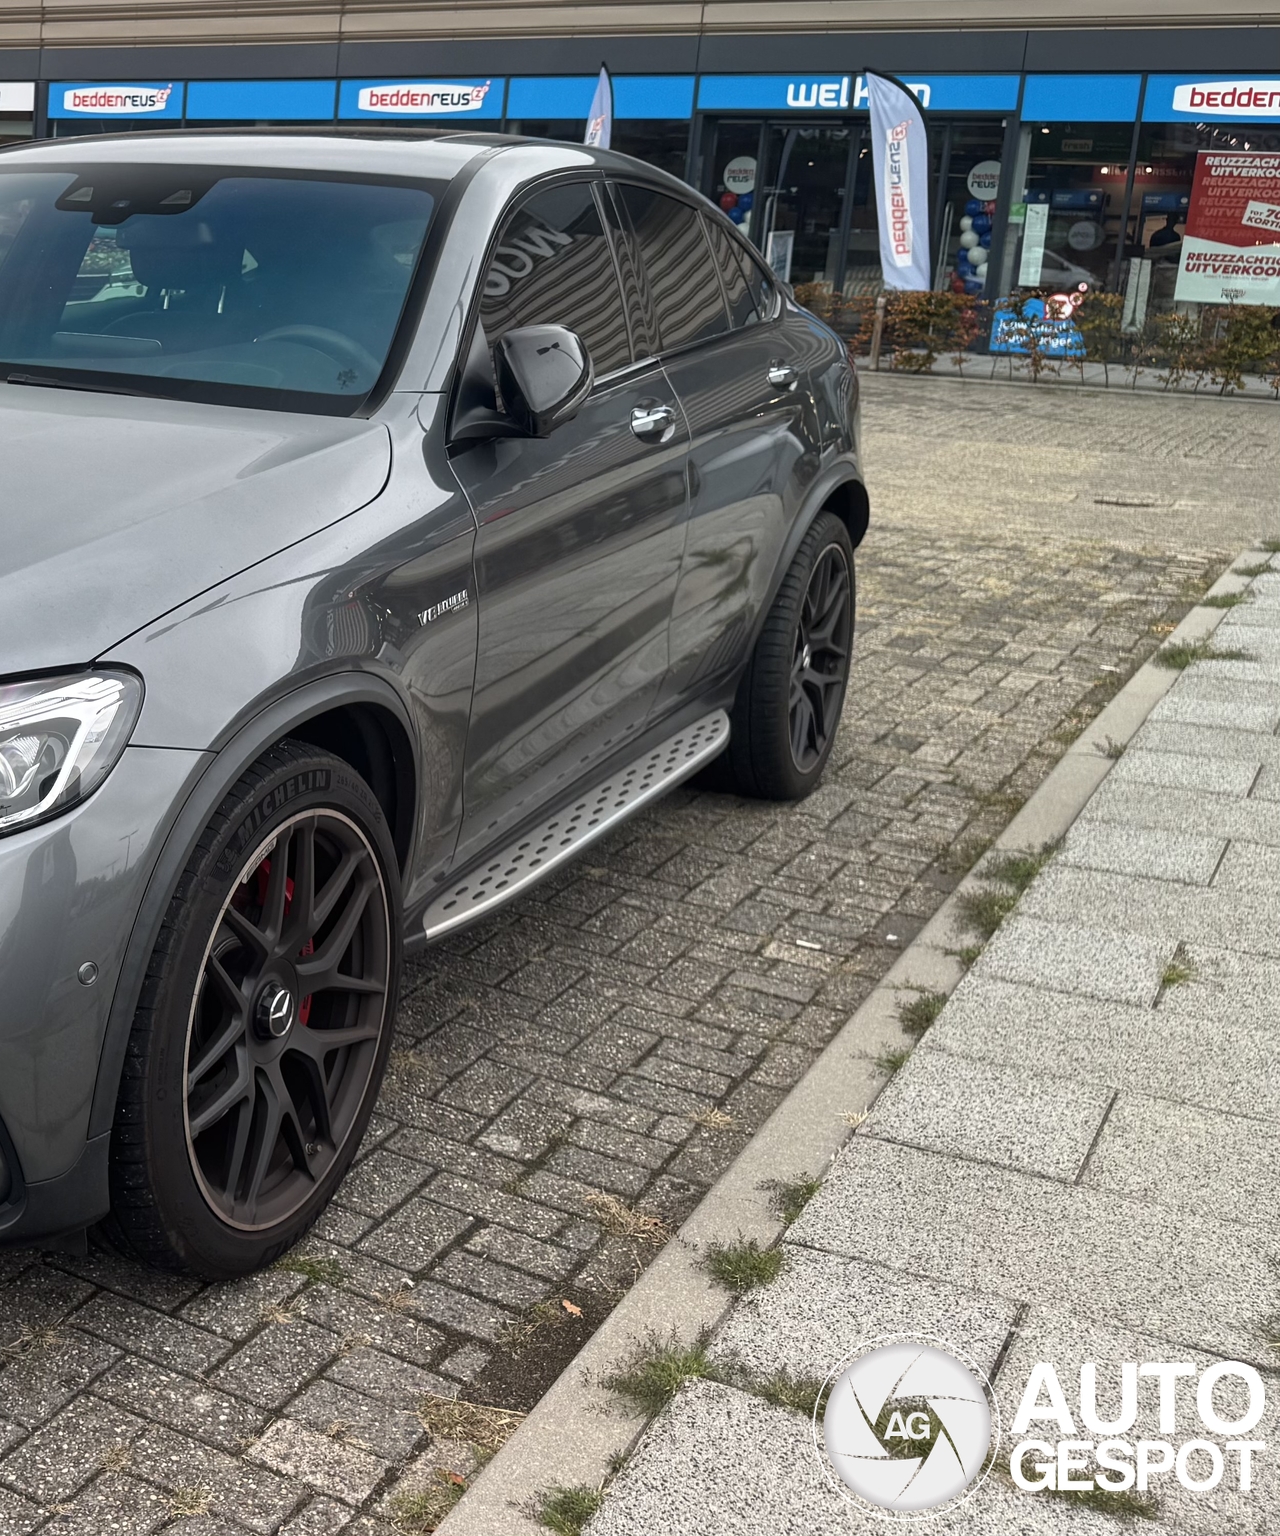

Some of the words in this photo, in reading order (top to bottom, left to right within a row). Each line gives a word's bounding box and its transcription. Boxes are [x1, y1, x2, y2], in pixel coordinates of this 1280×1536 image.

[786, 77, 930, 108] welkm
[1205, 156, 1280, 168] REUZZZACH
[971, 180, 996, 188] reus
[238, 770, 328, 842] MICHELIN
